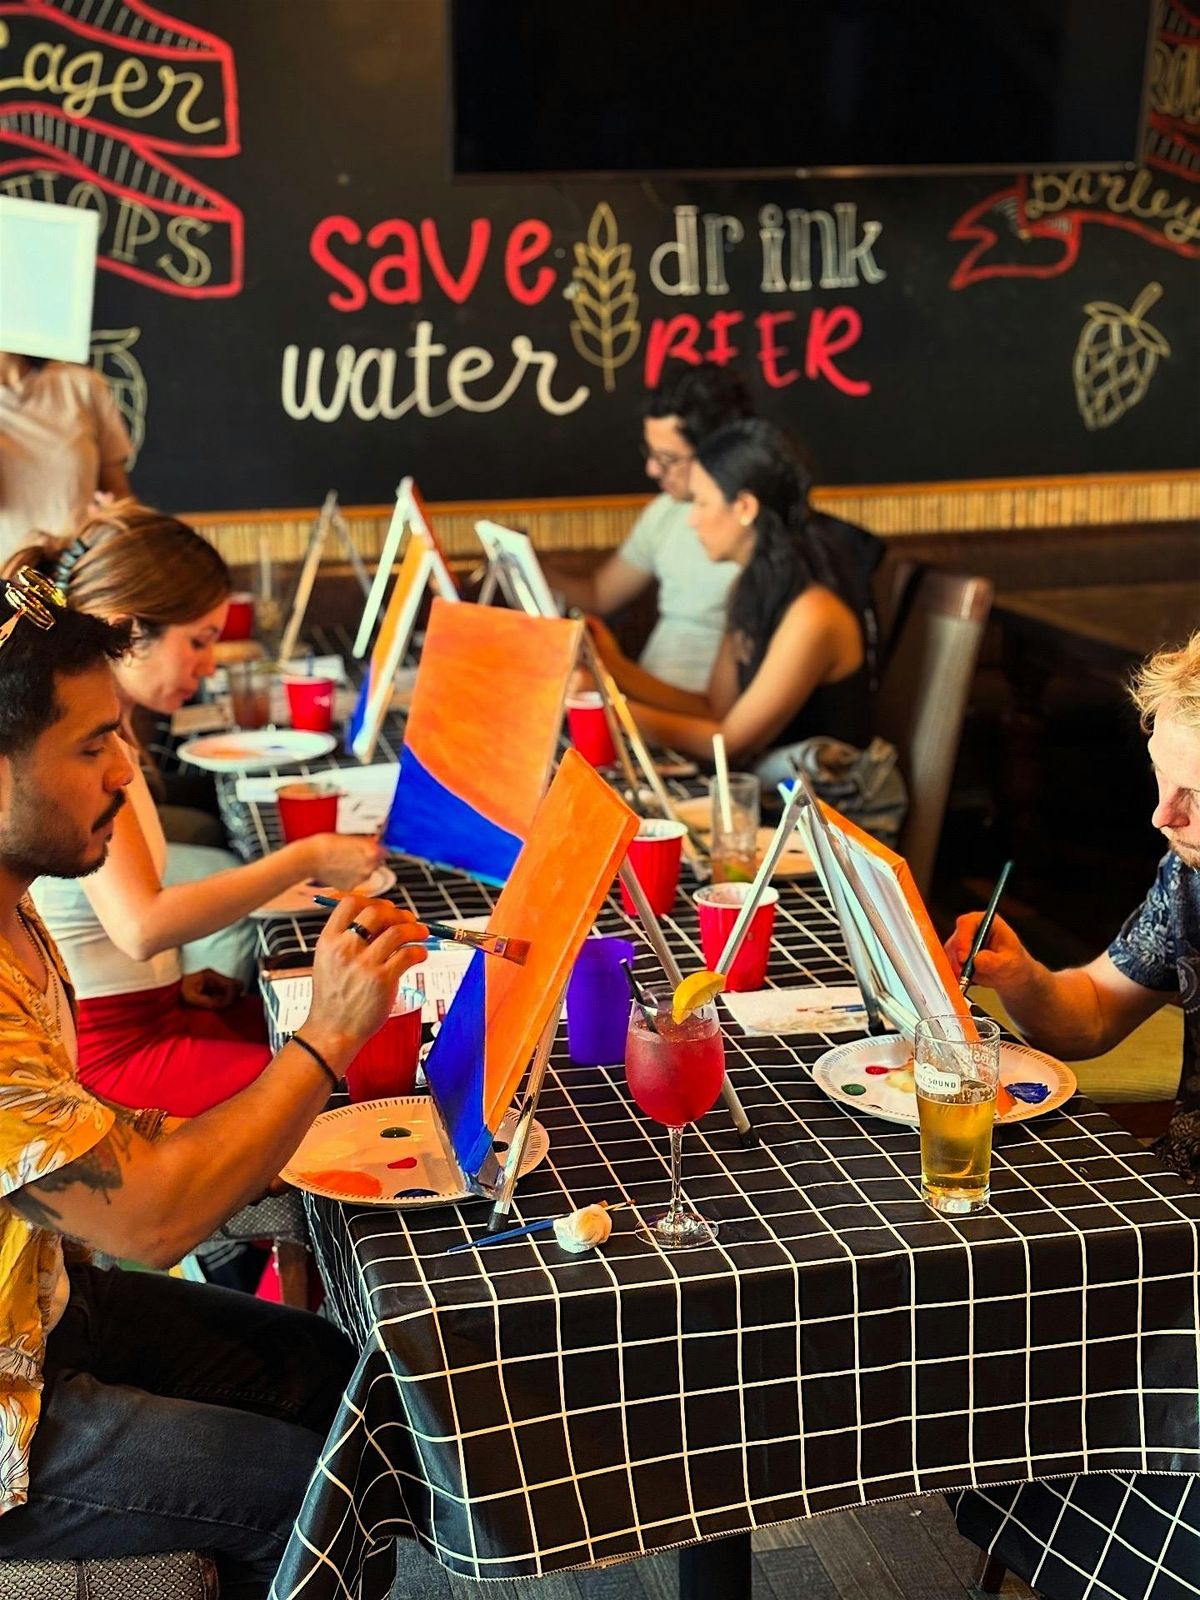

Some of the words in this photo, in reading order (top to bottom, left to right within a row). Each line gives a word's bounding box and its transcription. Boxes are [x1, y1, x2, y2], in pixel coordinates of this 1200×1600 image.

[0, 19, 221, 134] ager
[309, 214, 557, 312] save
[650, 203, 887, 295] drink
[281, 320, 590, 422] water
